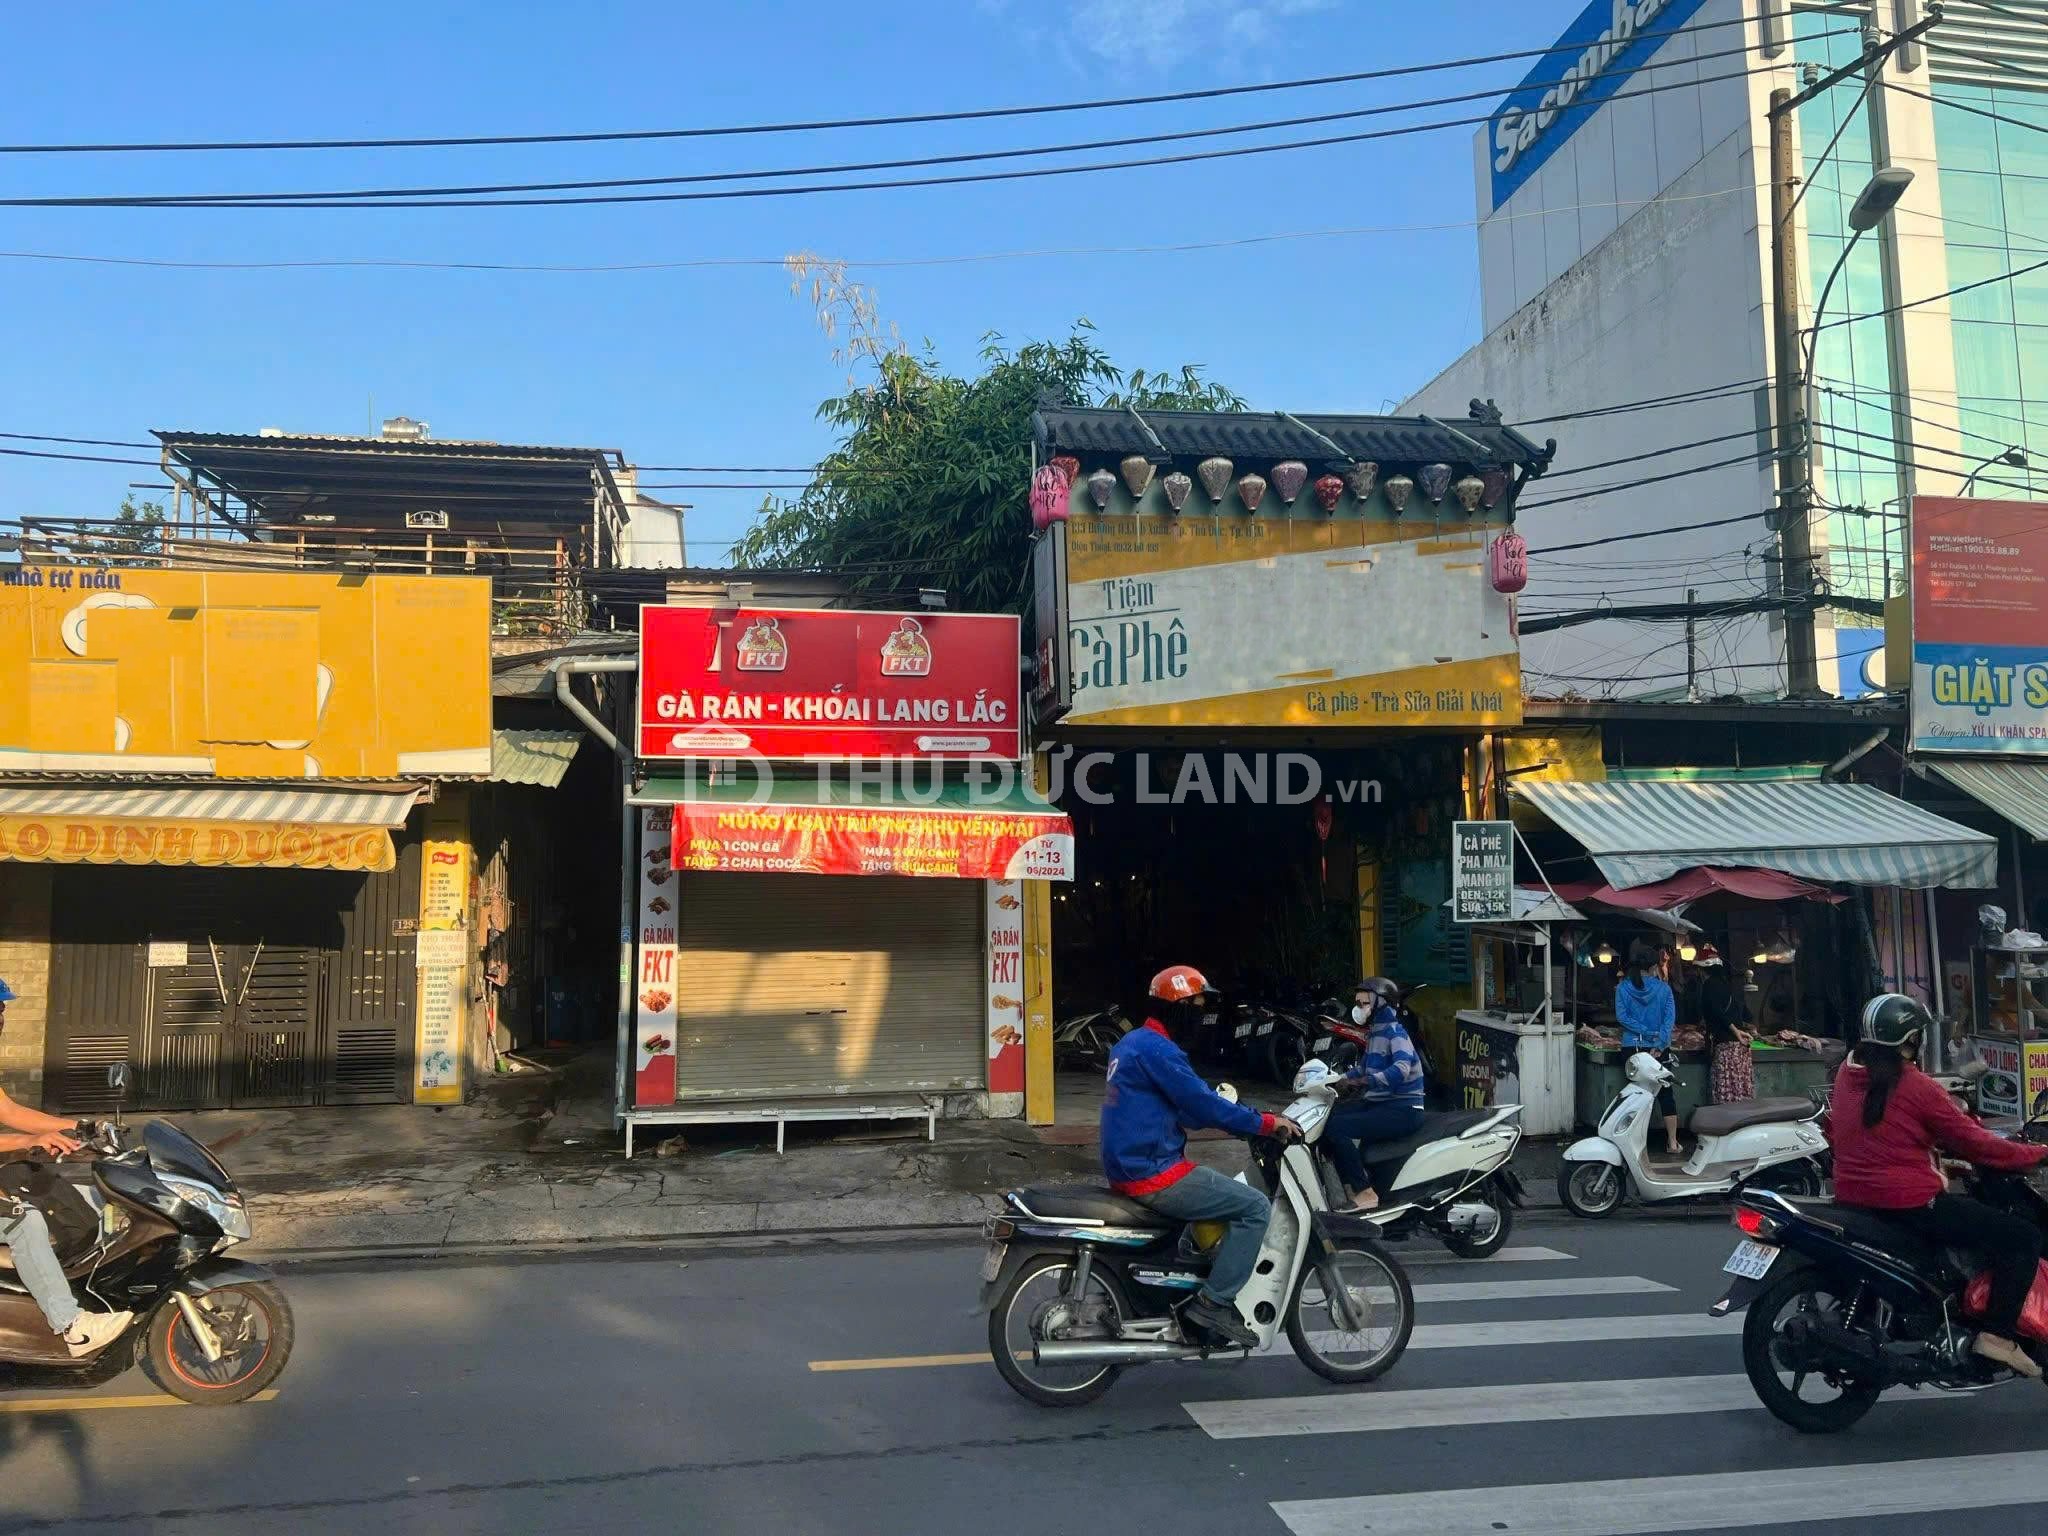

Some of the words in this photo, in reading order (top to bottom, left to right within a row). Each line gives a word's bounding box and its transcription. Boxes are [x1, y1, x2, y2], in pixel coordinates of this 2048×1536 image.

[1494, 0, 1668, 173] Sacomba
[1102, 578, 1154, 613] Tiệm
[745, 651, 781, 667] FKT
[1118, 617, 1188, 687] Phê
[888, 656, 922, 671] FKT
[1932, 658, 2015, 715] GIẶT
[656, 688, 696, 719] GÀ
[877, 698, 949, 723] LANG
[1306, 690, 1326, 712] Cà
[1331, 689, 1359, 716] phê
[1371, 690, 1399, 713] Trà
[64, 822, 197, 860] DINH
[690, 839, 720, 851] MUA
[723, 841, 729, 852] 1
[731, 841, 759, 852] CON
[762, 840, 779, 853] GÀ
[1464, 834, 1478, 851] CÀ
[1481, 834, 1502, 851] PHÊ
[721, 857, 728, 867] 2
[731, 857, 764, 868] CHAI
[1024, 850, 1061, 864] 11-13
[1459, 854, 1480, 868] PHA
[1483, 852, 1507, 868] MÁY
[1026, 866, 1065, 877] 06/2024
[1460, 873, 1492, 887] MANG
[643, 923, 656, 944] GÀ
[656, 922, 674, 944] RÁN
[1003, 925, 1019, 946] RÁN
[642, 950, 674, 984] FKT
[991, 951, 1020, 984] FKT
[1459, 1030, 1490, 1060] Coffee
